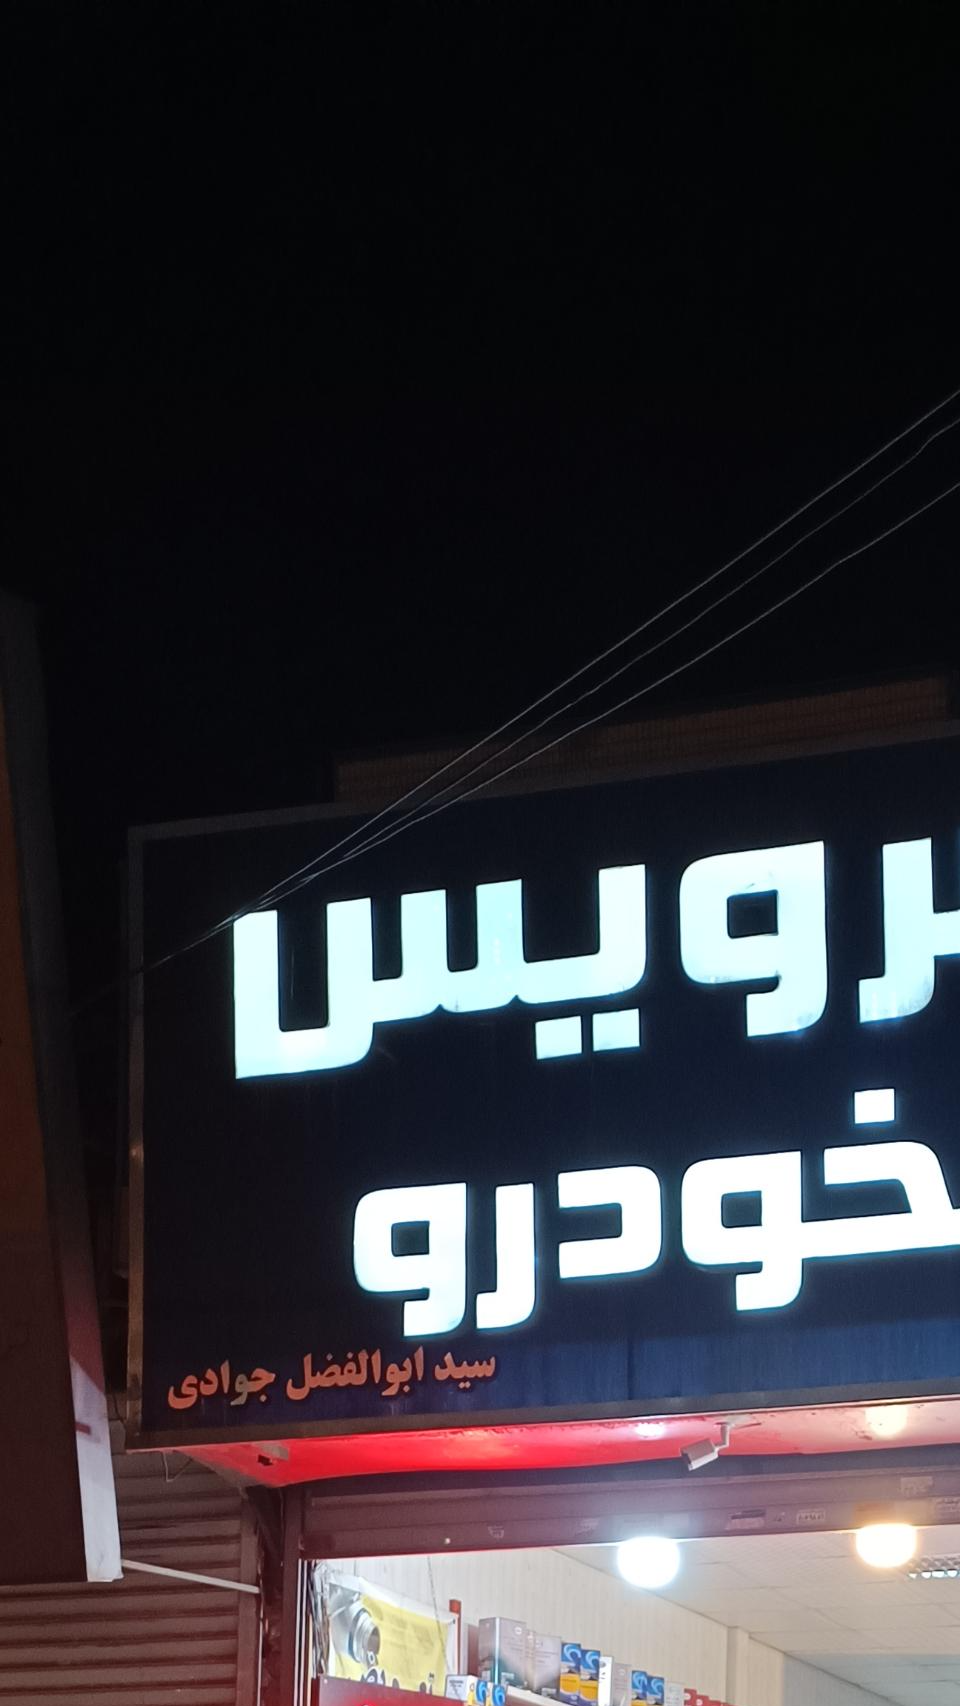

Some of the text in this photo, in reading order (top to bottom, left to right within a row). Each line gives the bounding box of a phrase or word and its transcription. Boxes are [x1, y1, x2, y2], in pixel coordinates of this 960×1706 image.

[166, 1345, 496, 1410] سید ابوالفضل جوادی
